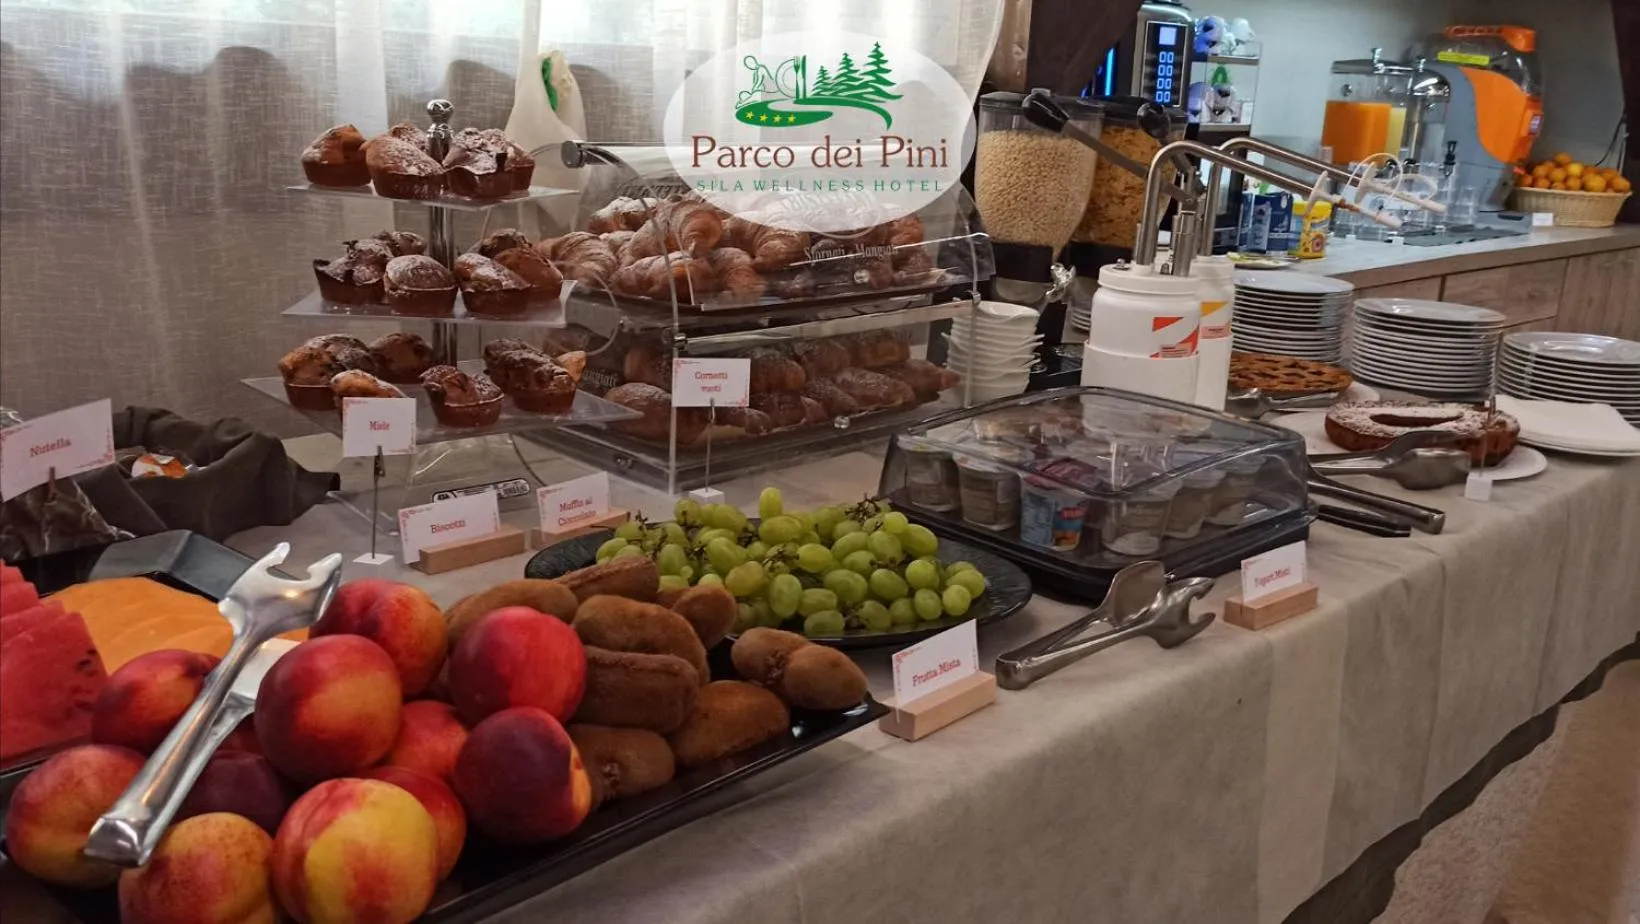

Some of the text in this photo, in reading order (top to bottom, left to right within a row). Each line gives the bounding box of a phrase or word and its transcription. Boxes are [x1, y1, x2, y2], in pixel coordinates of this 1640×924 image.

[29, 438, 72, 458] Nutella
[559, 499, 584, 513] Muffin
[430, 518, 466, 534] Biscotti
[912, 658, 961, 687] Frutta Mista
